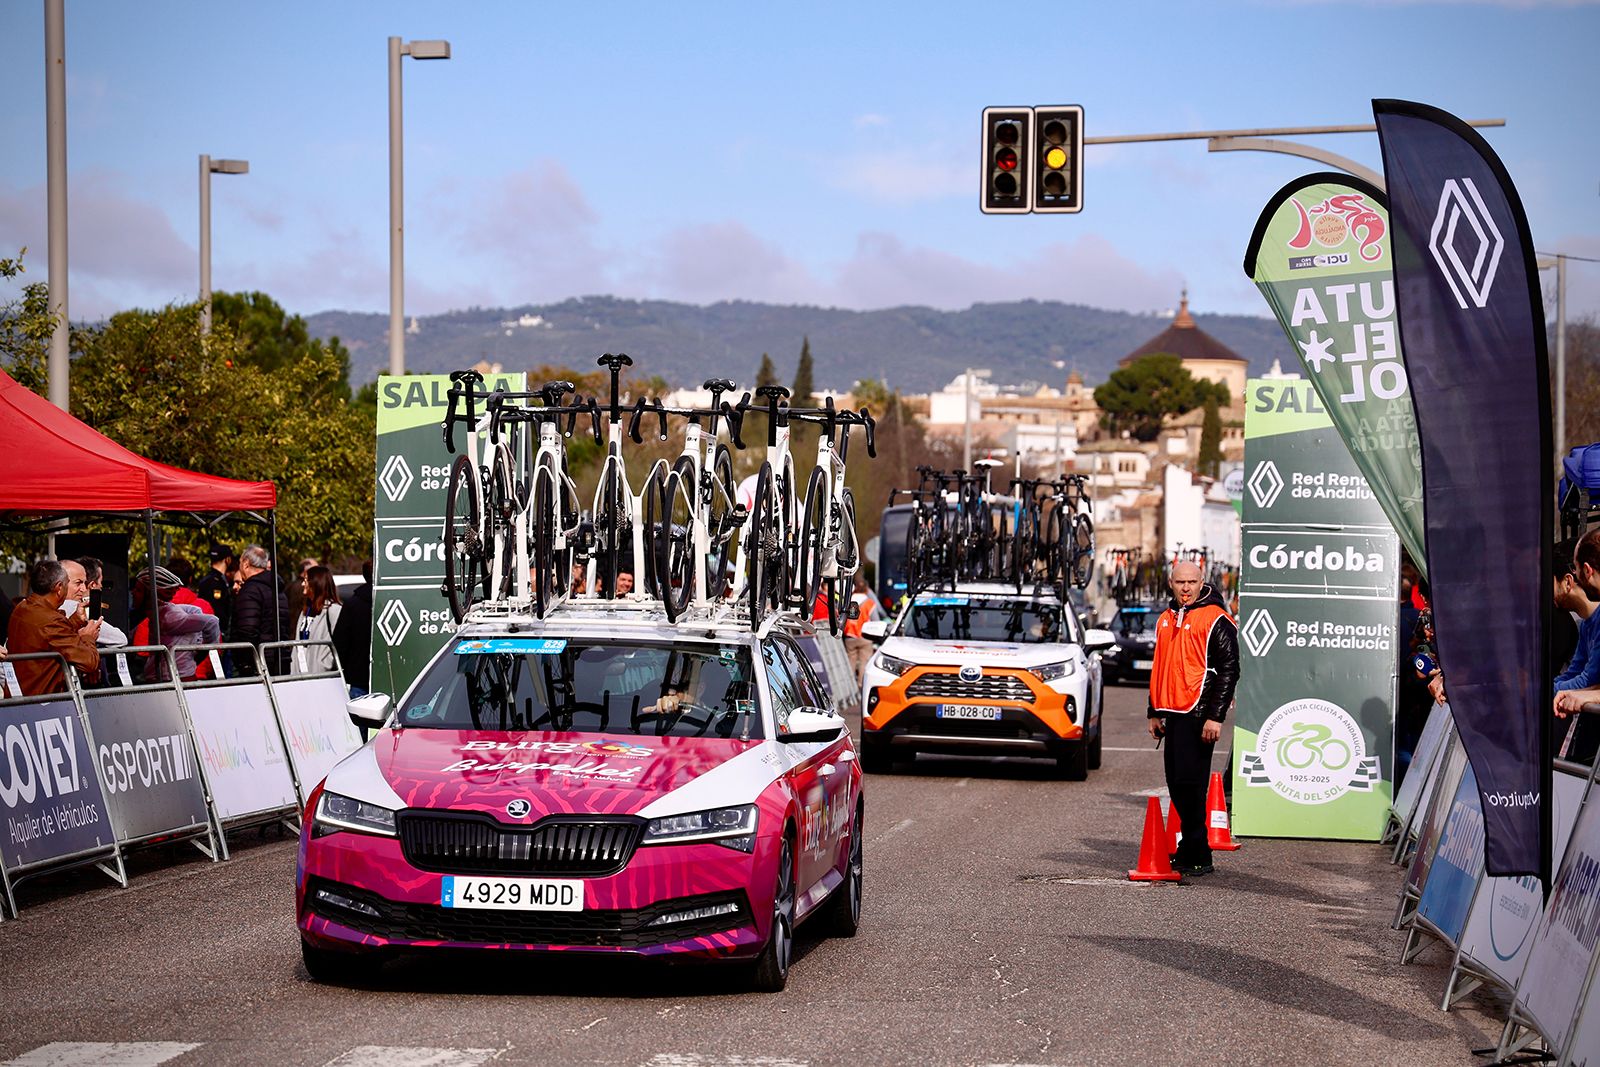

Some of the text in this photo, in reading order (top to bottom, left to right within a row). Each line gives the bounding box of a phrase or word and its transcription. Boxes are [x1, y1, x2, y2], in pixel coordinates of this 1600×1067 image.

[421, 463, 450, 478] Red
[421, 477, 440, 490] de
[1293, 472, 1324, 486] Red
[1291, 486, 1311, 498] de
[1249, 543, 1384, 572] Córdoba
[419, 607, 450, 622] Red
[418, 621, 439, 635] de
[1286, 621, 1391, 637] Red Renault
[544, 640, 564, 648] 629
[1286, 635, 1390, 651] de Andalucía
[1260, 713, 1284, 752] CENTENARIO
[1283, 703, 1308, 716] VUELTA
[1309, 703, 1338, 717] CICLISTA
[1342, 718, 1361, 757] ANDALUCÍA
[440, 758, 643, 778] Burpellet
[1289, 775, 1331, 783] 1925-2025
[1274, 780, 1344, 801] RUTA DEL SOL
[9, 799, 99, 849] Alquiler de Vehículos
[463, 882, 574, 905] 4929 MDD
